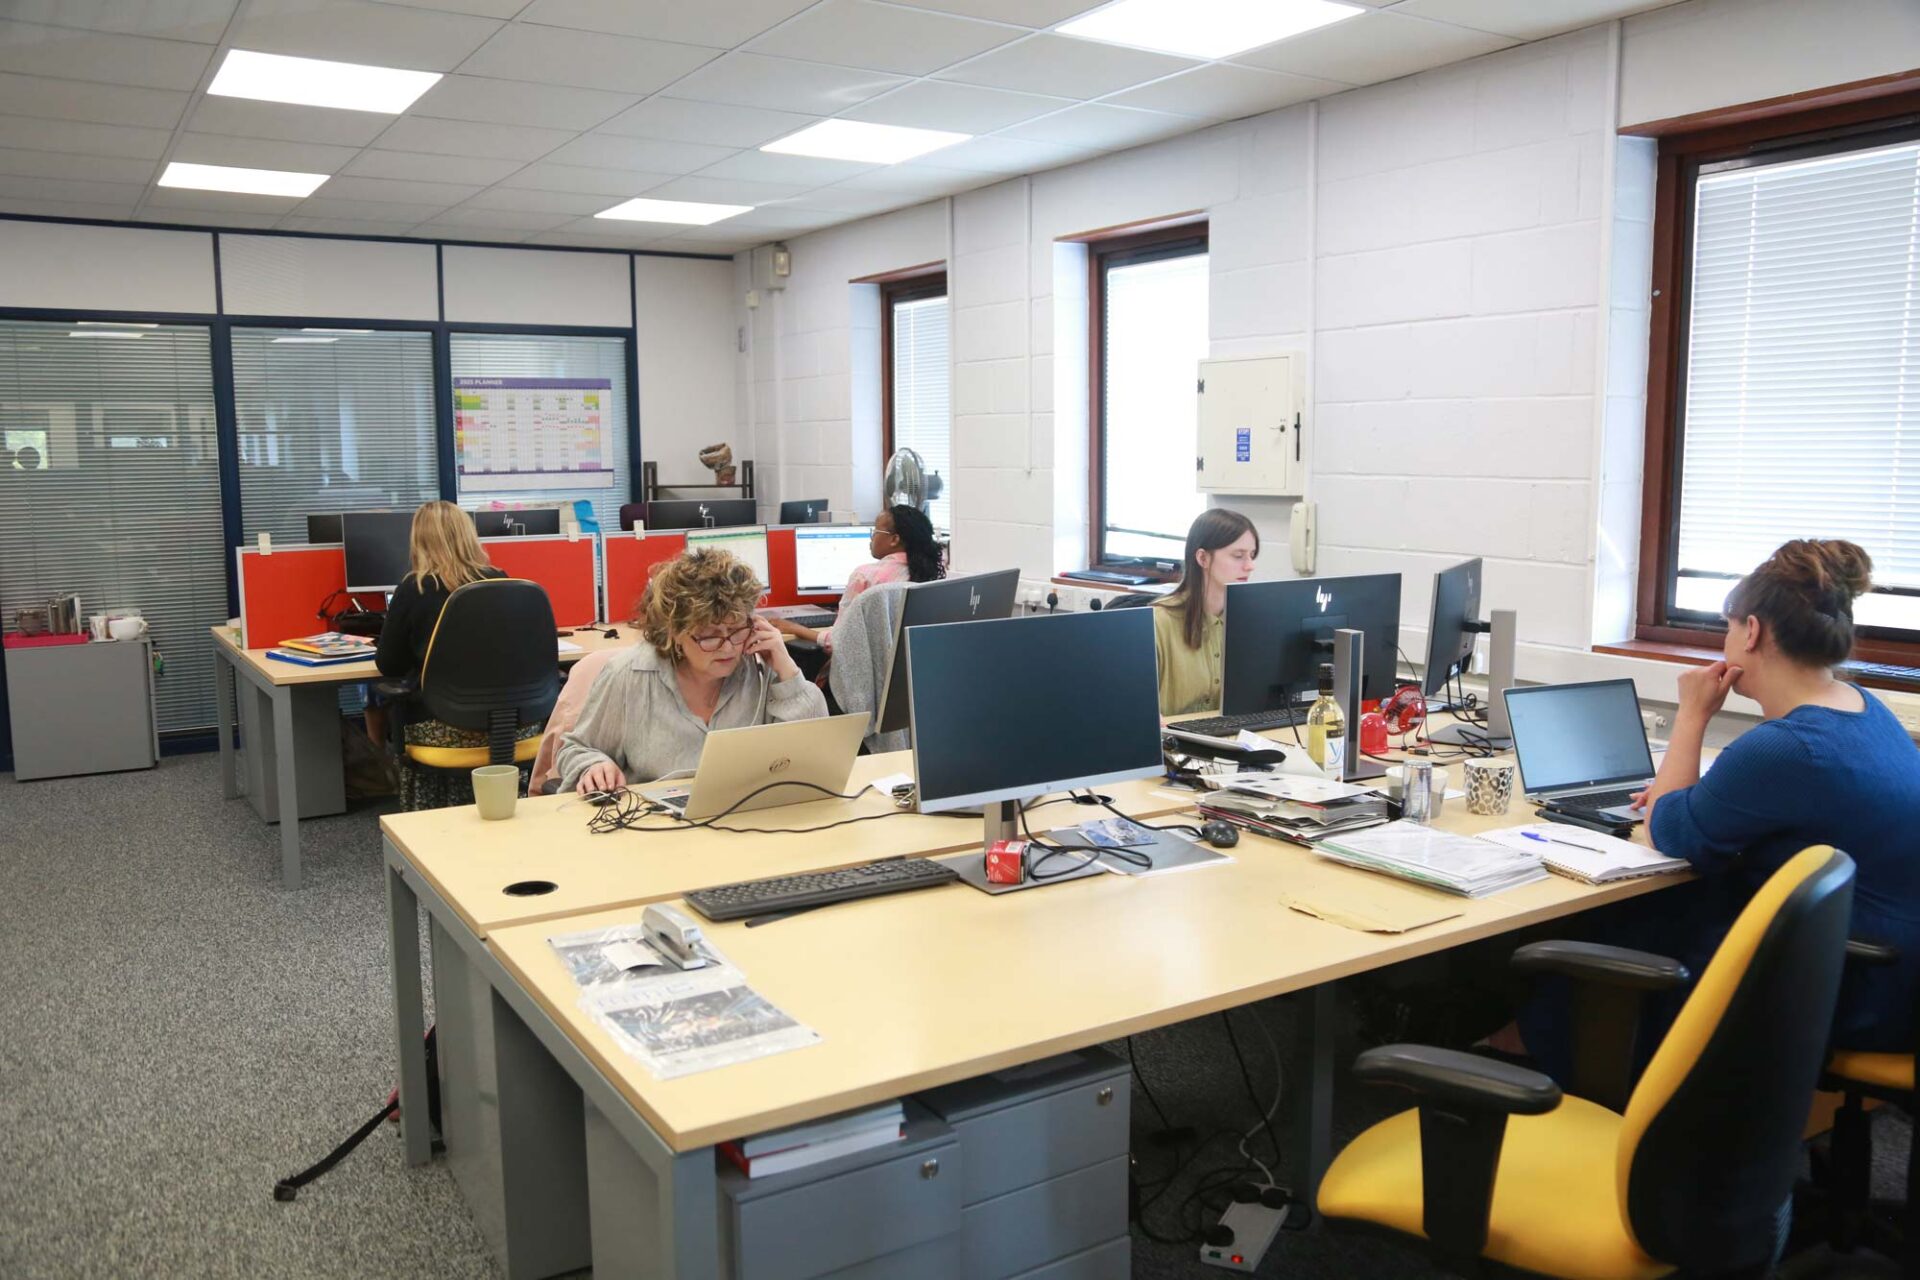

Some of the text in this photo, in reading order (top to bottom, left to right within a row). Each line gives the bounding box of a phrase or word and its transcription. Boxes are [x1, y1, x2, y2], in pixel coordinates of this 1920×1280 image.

[503, 513, 514, 528] hp
[969, 585, 981, 615] hp
[1316, 584, 1332, 612] hp
